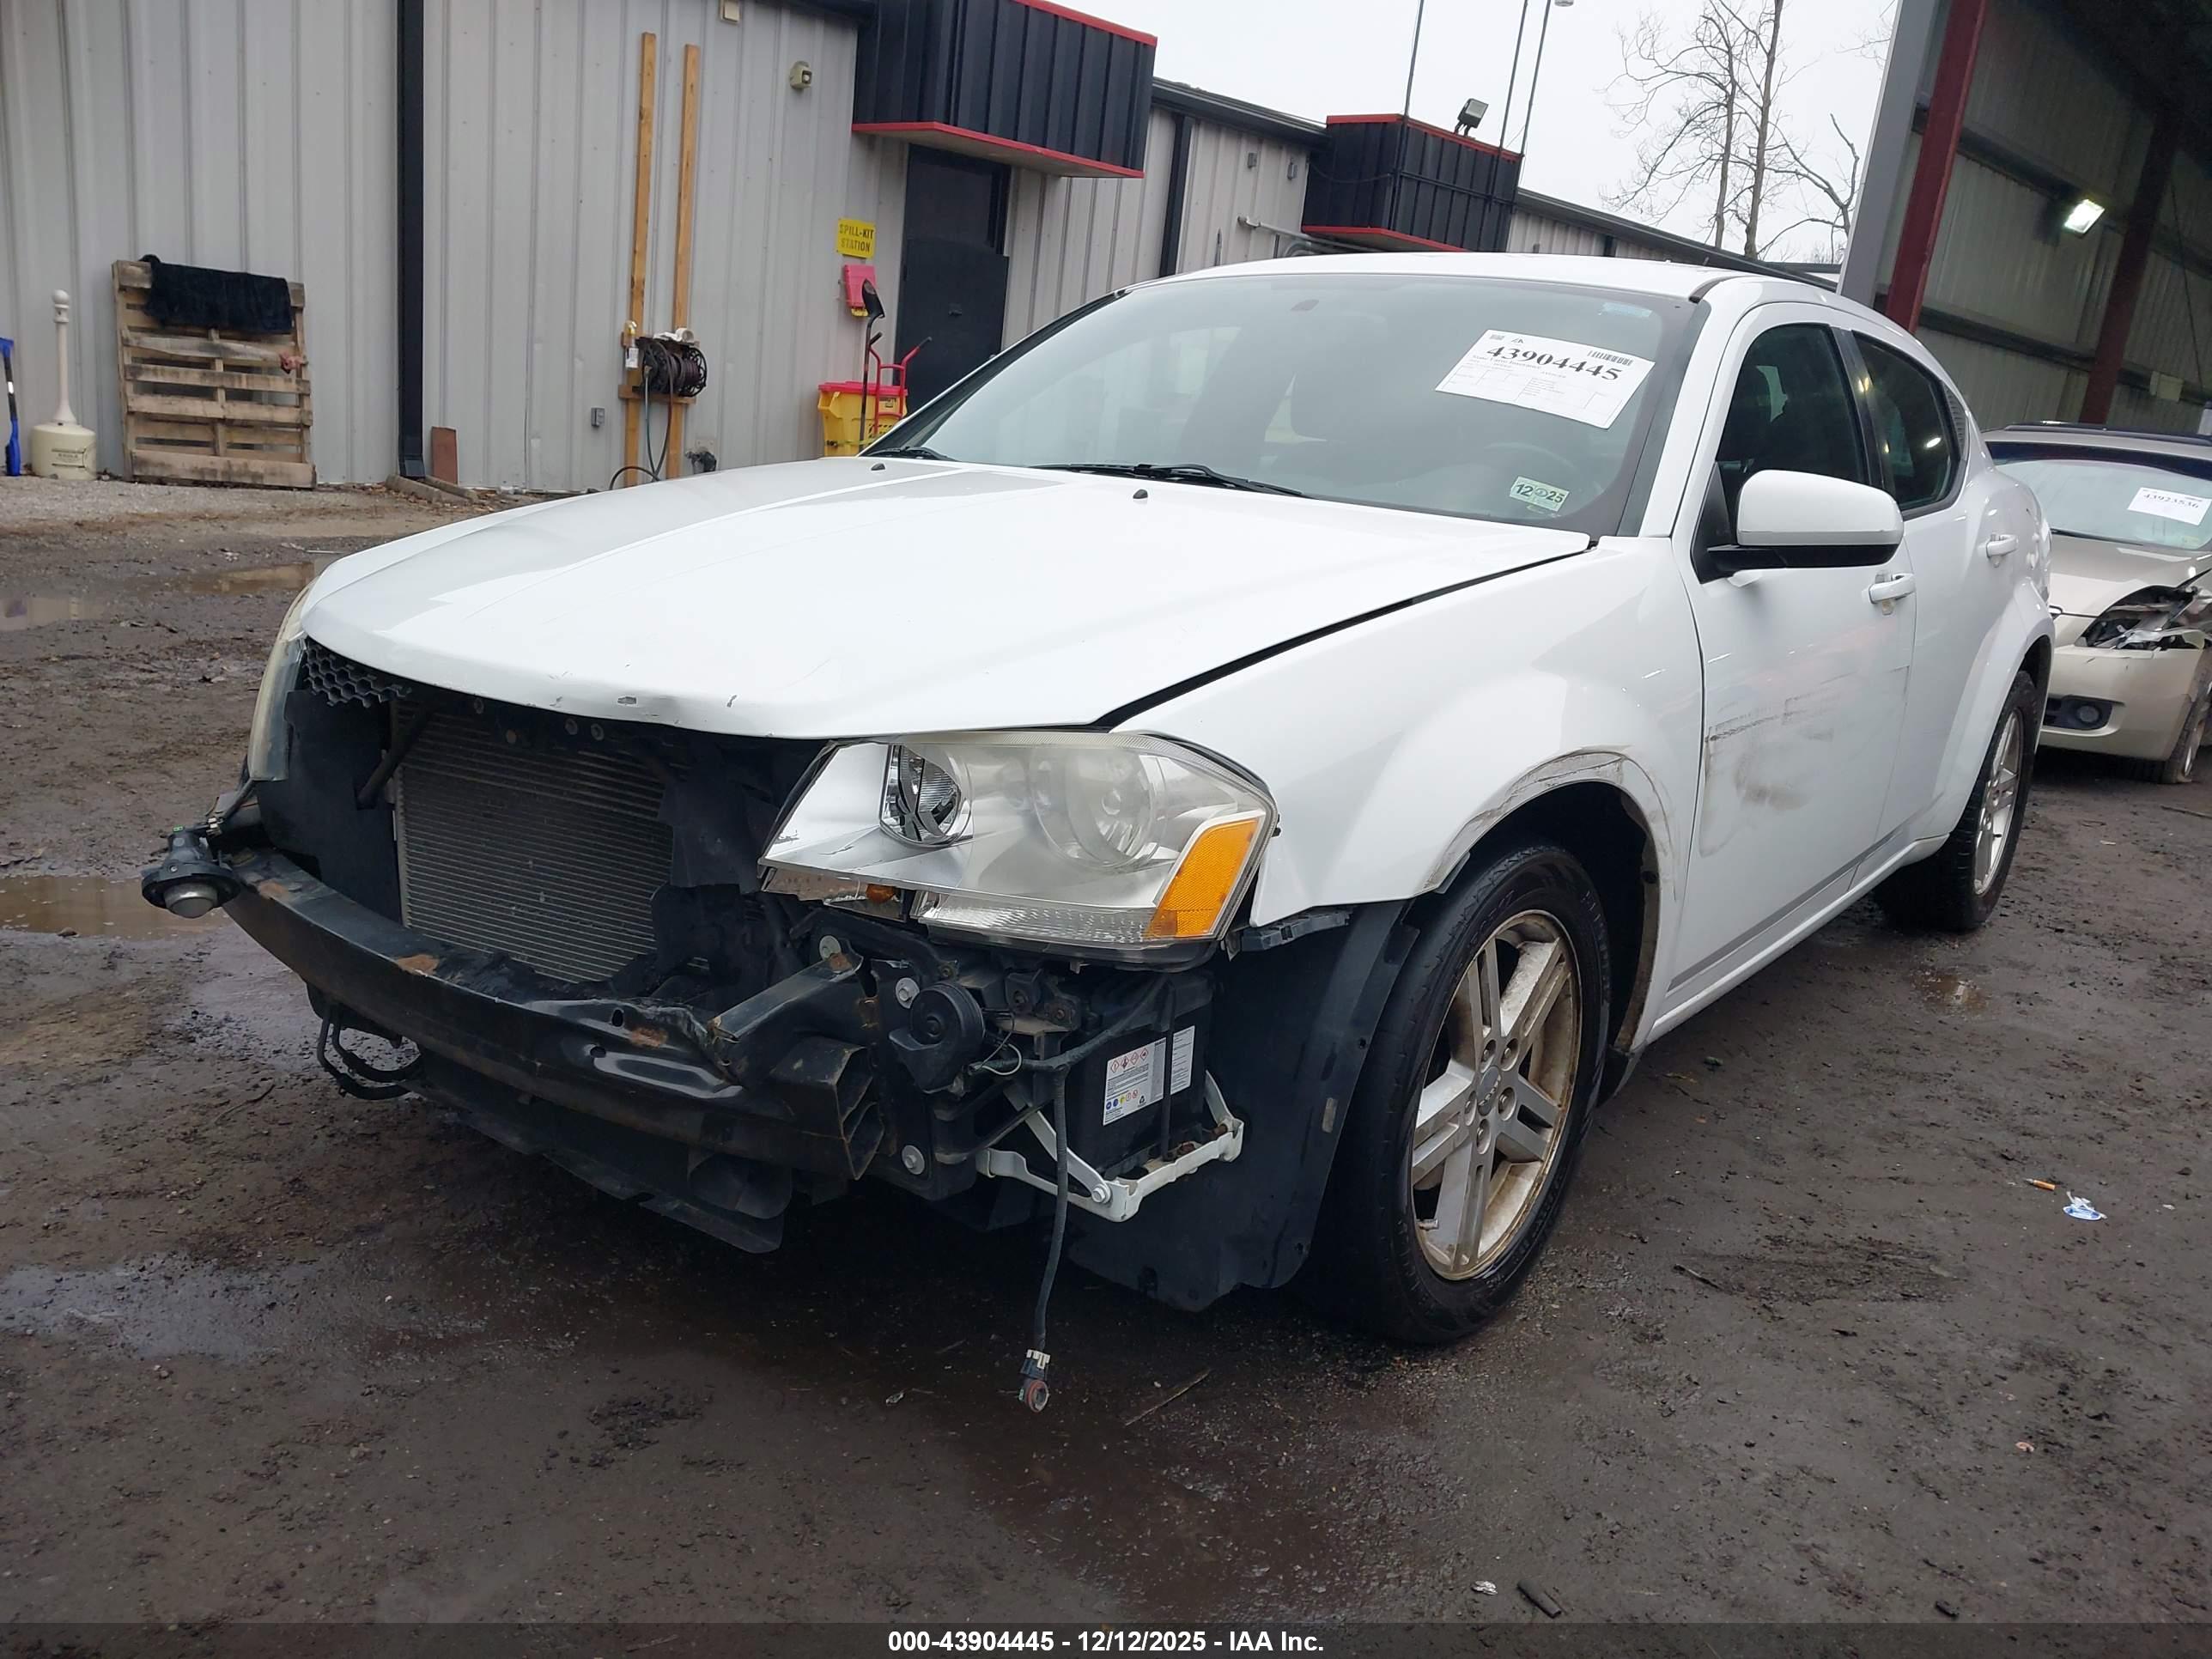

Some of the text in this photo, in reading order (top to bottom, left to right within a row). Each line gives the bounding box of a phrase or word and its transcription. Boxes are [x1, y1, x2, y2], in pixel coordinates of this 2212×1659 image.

[840, 224, 874, 239] SPILL-KIT
[841, 238, 871, 252] STATION
[1486, 346, 1622, 380] 43904445
[1516, 483, 1565, 503] 12 25
